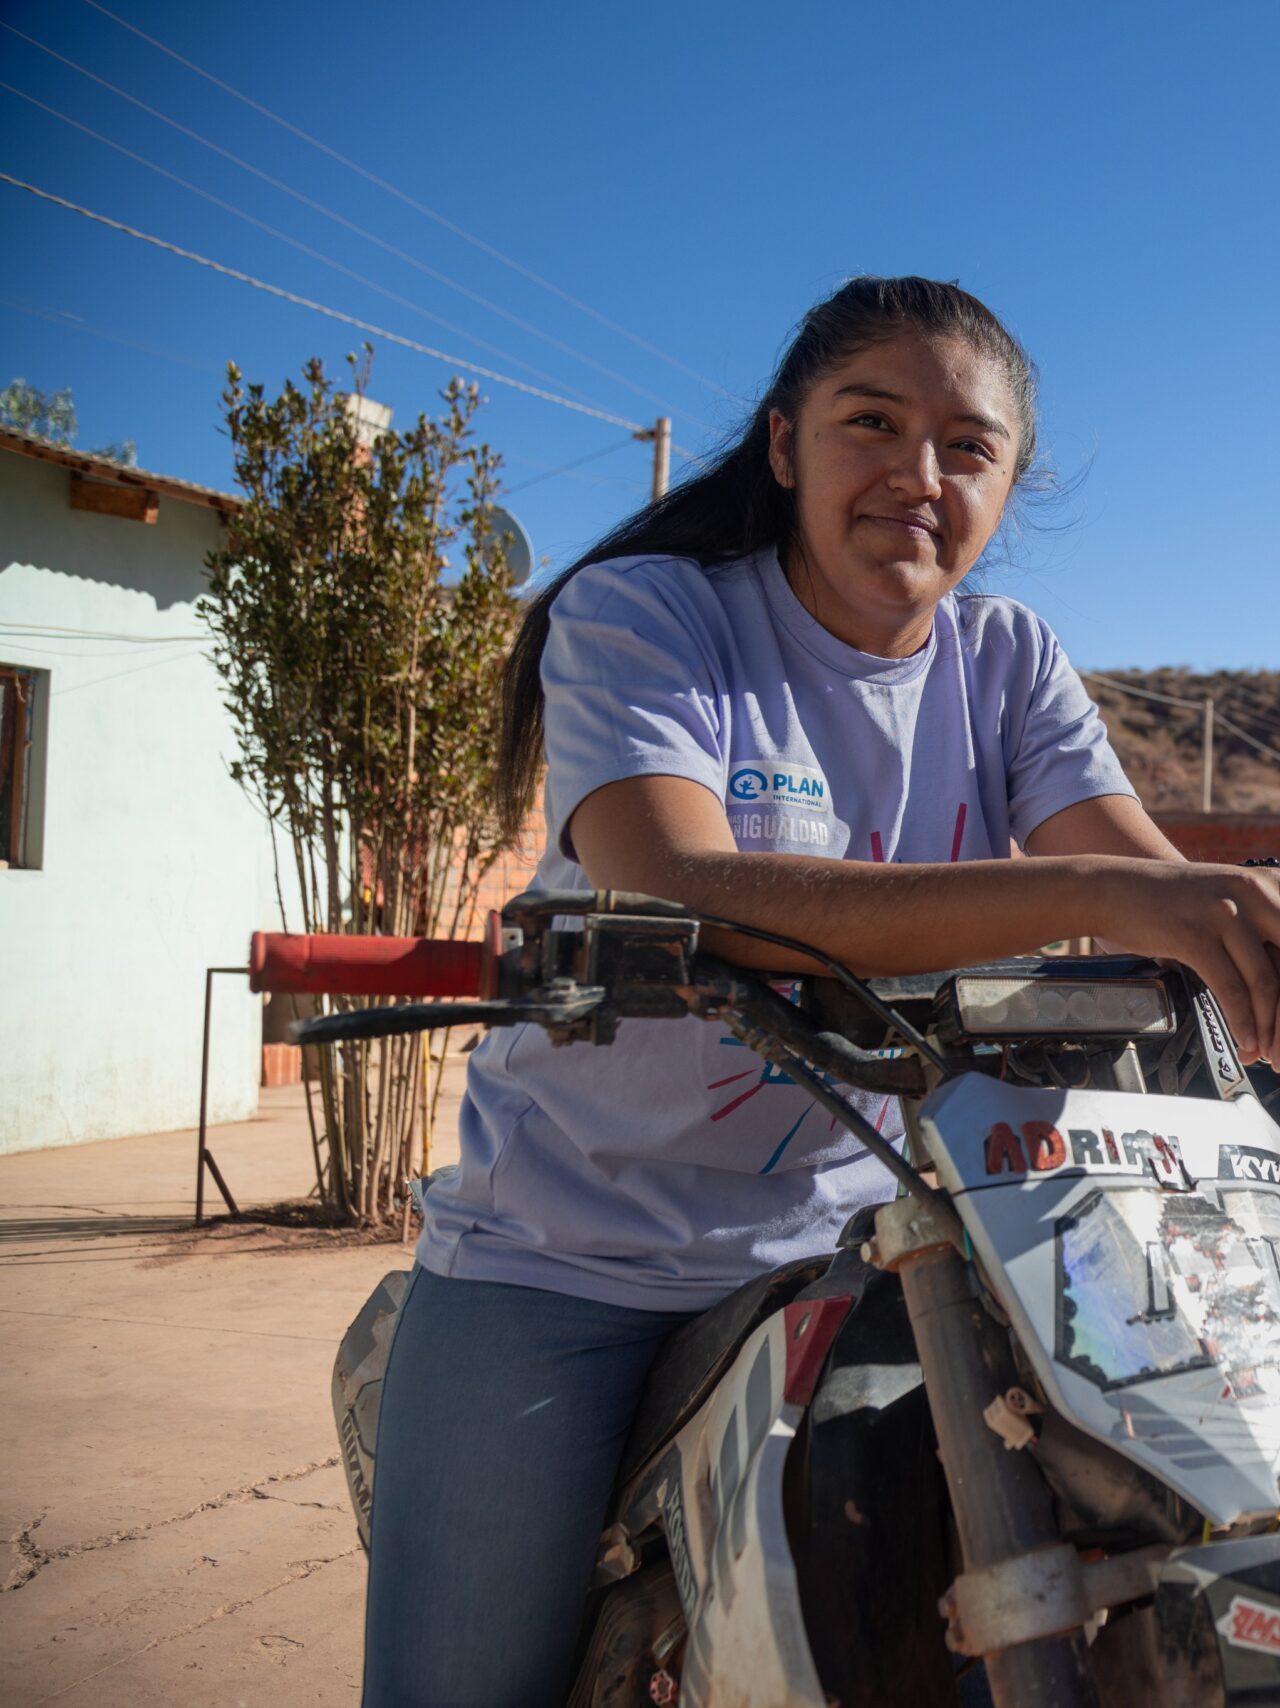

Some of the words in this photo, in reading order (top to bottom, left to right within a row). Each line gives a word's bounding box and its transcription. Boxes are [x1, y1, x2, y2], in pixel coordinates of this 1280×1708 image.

[773, 773, 824, 798] PLAN
[773, 794, 822, 808] INTERNATIONAL
[742, 813, 828, 846] IGUALDAD
